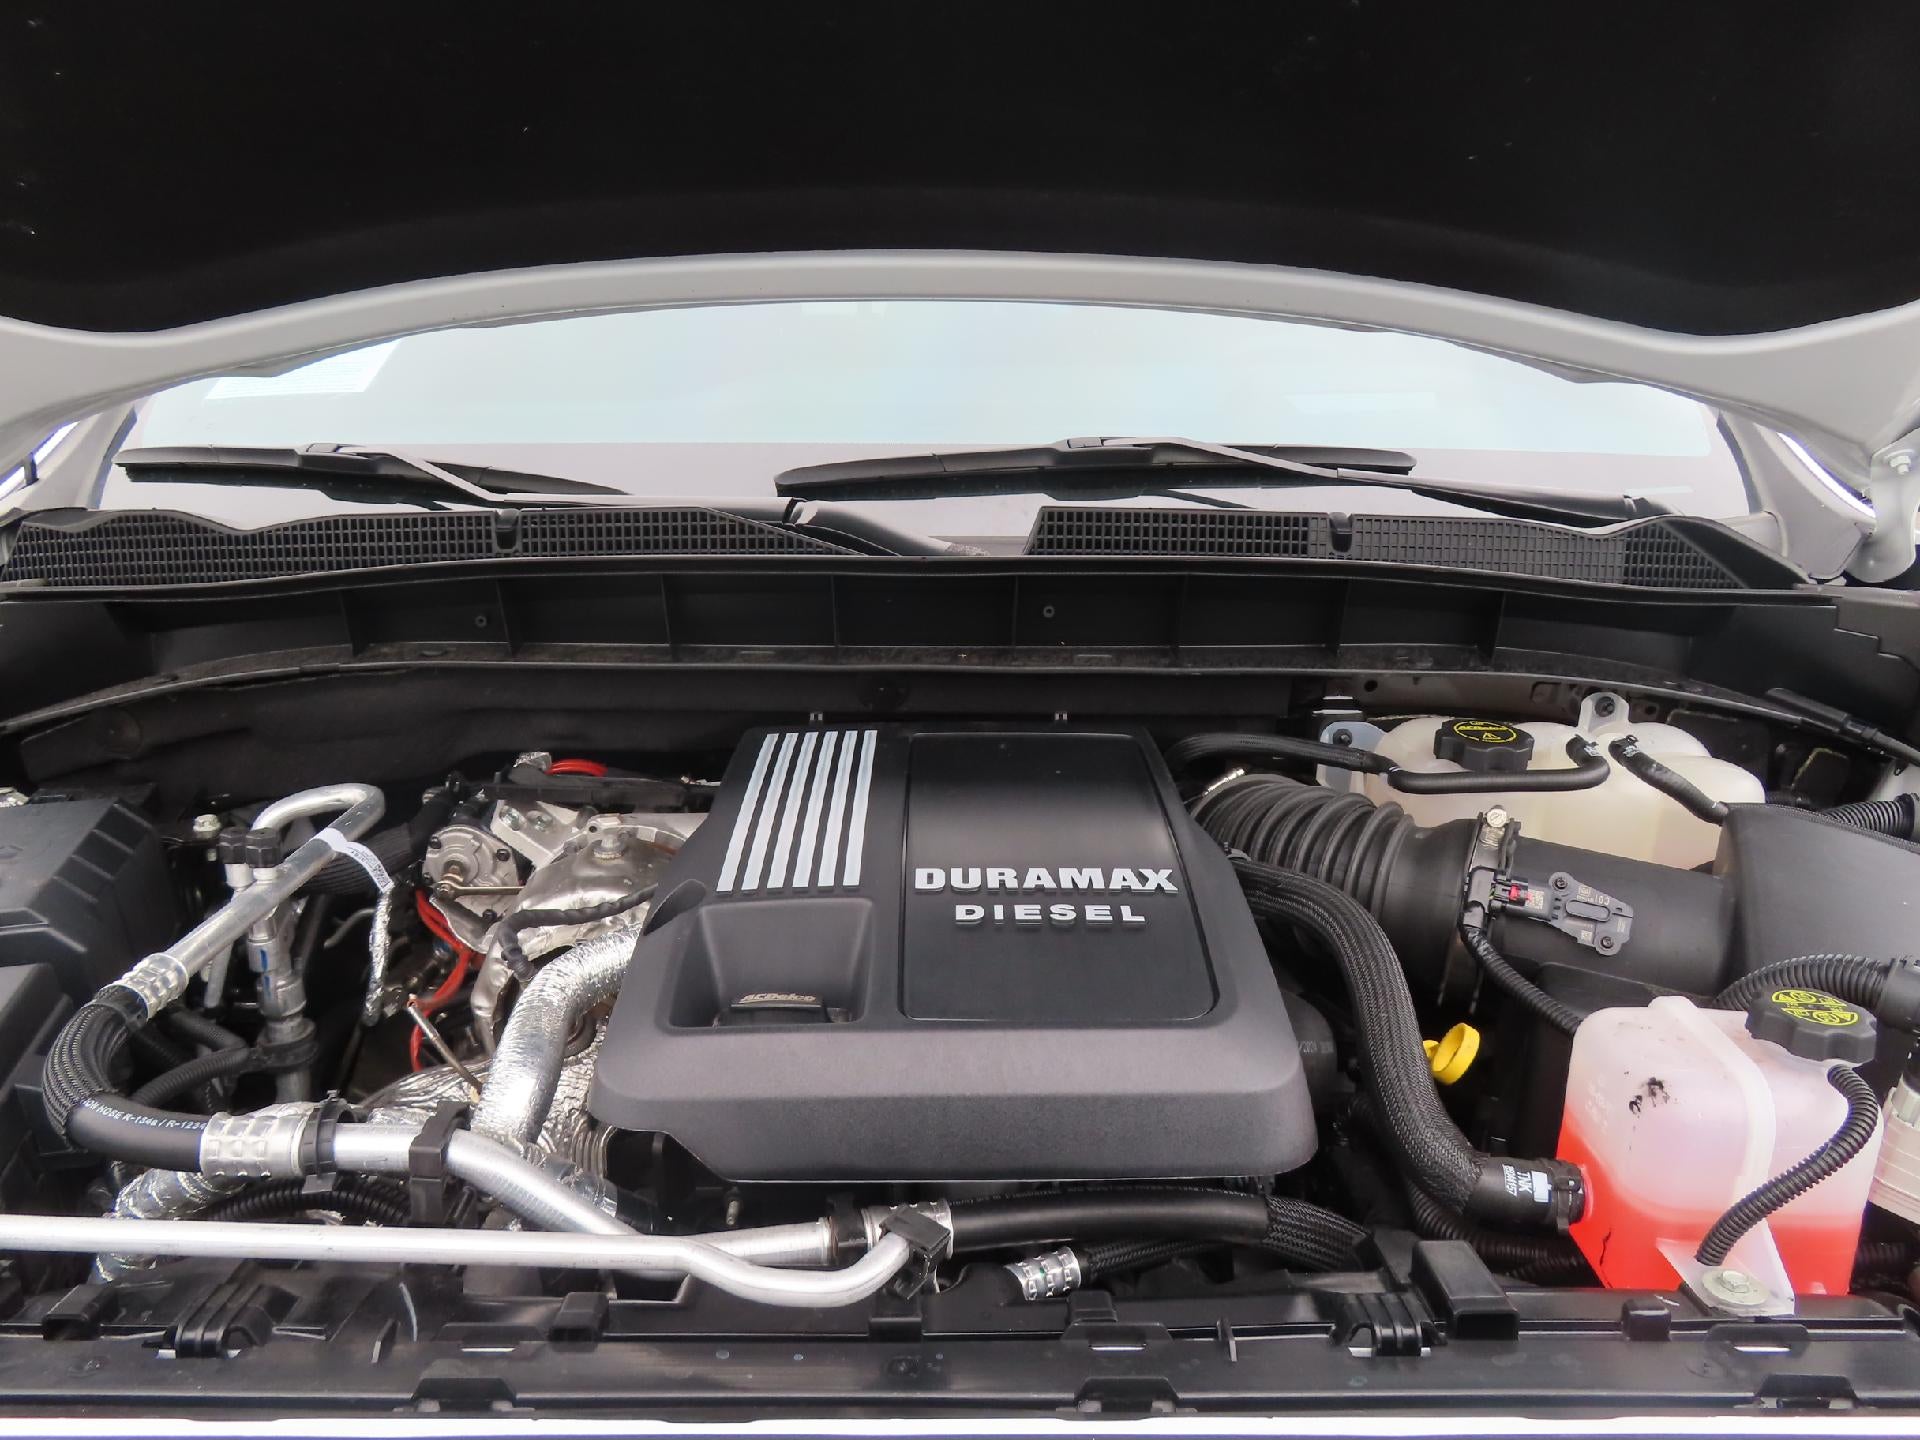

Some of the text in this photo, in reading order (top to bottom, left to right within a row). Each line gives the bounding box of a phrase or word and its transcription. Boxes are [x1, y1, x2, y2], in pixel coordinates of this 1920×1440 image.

[914, 867, 1179, 892] DURAMAX
[955, 904, 1146, 923] DIESEL
[97, 1105, 124, 1119] HOSE
